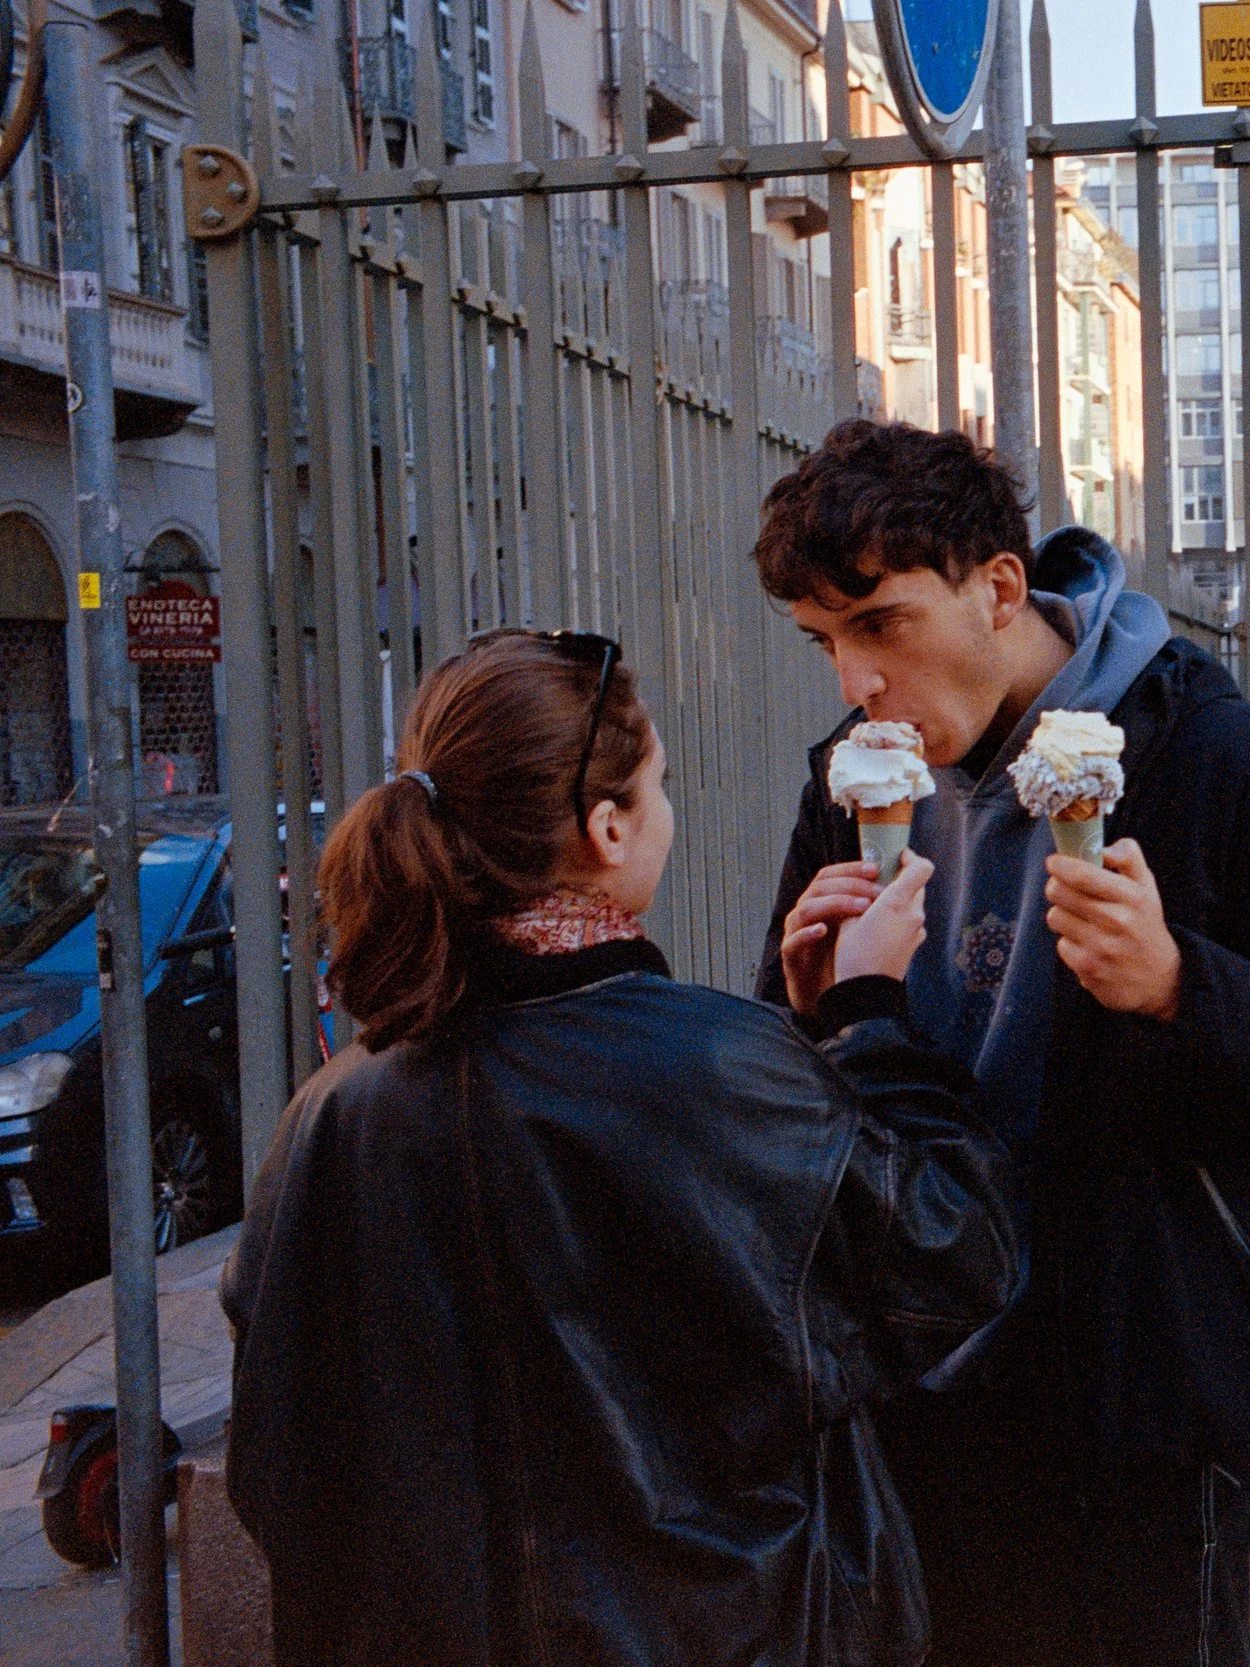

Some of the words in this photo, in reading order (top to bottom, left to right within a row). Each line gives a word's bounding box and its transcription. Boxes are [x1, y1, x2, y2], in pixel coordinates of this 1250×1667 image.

[128, 598, 213, 611] ENOTECA
[128, 611, 214, 625] VINERIA
[130, 648, 159, 659] CON
[162, 648, 214, 659] CUCINA
